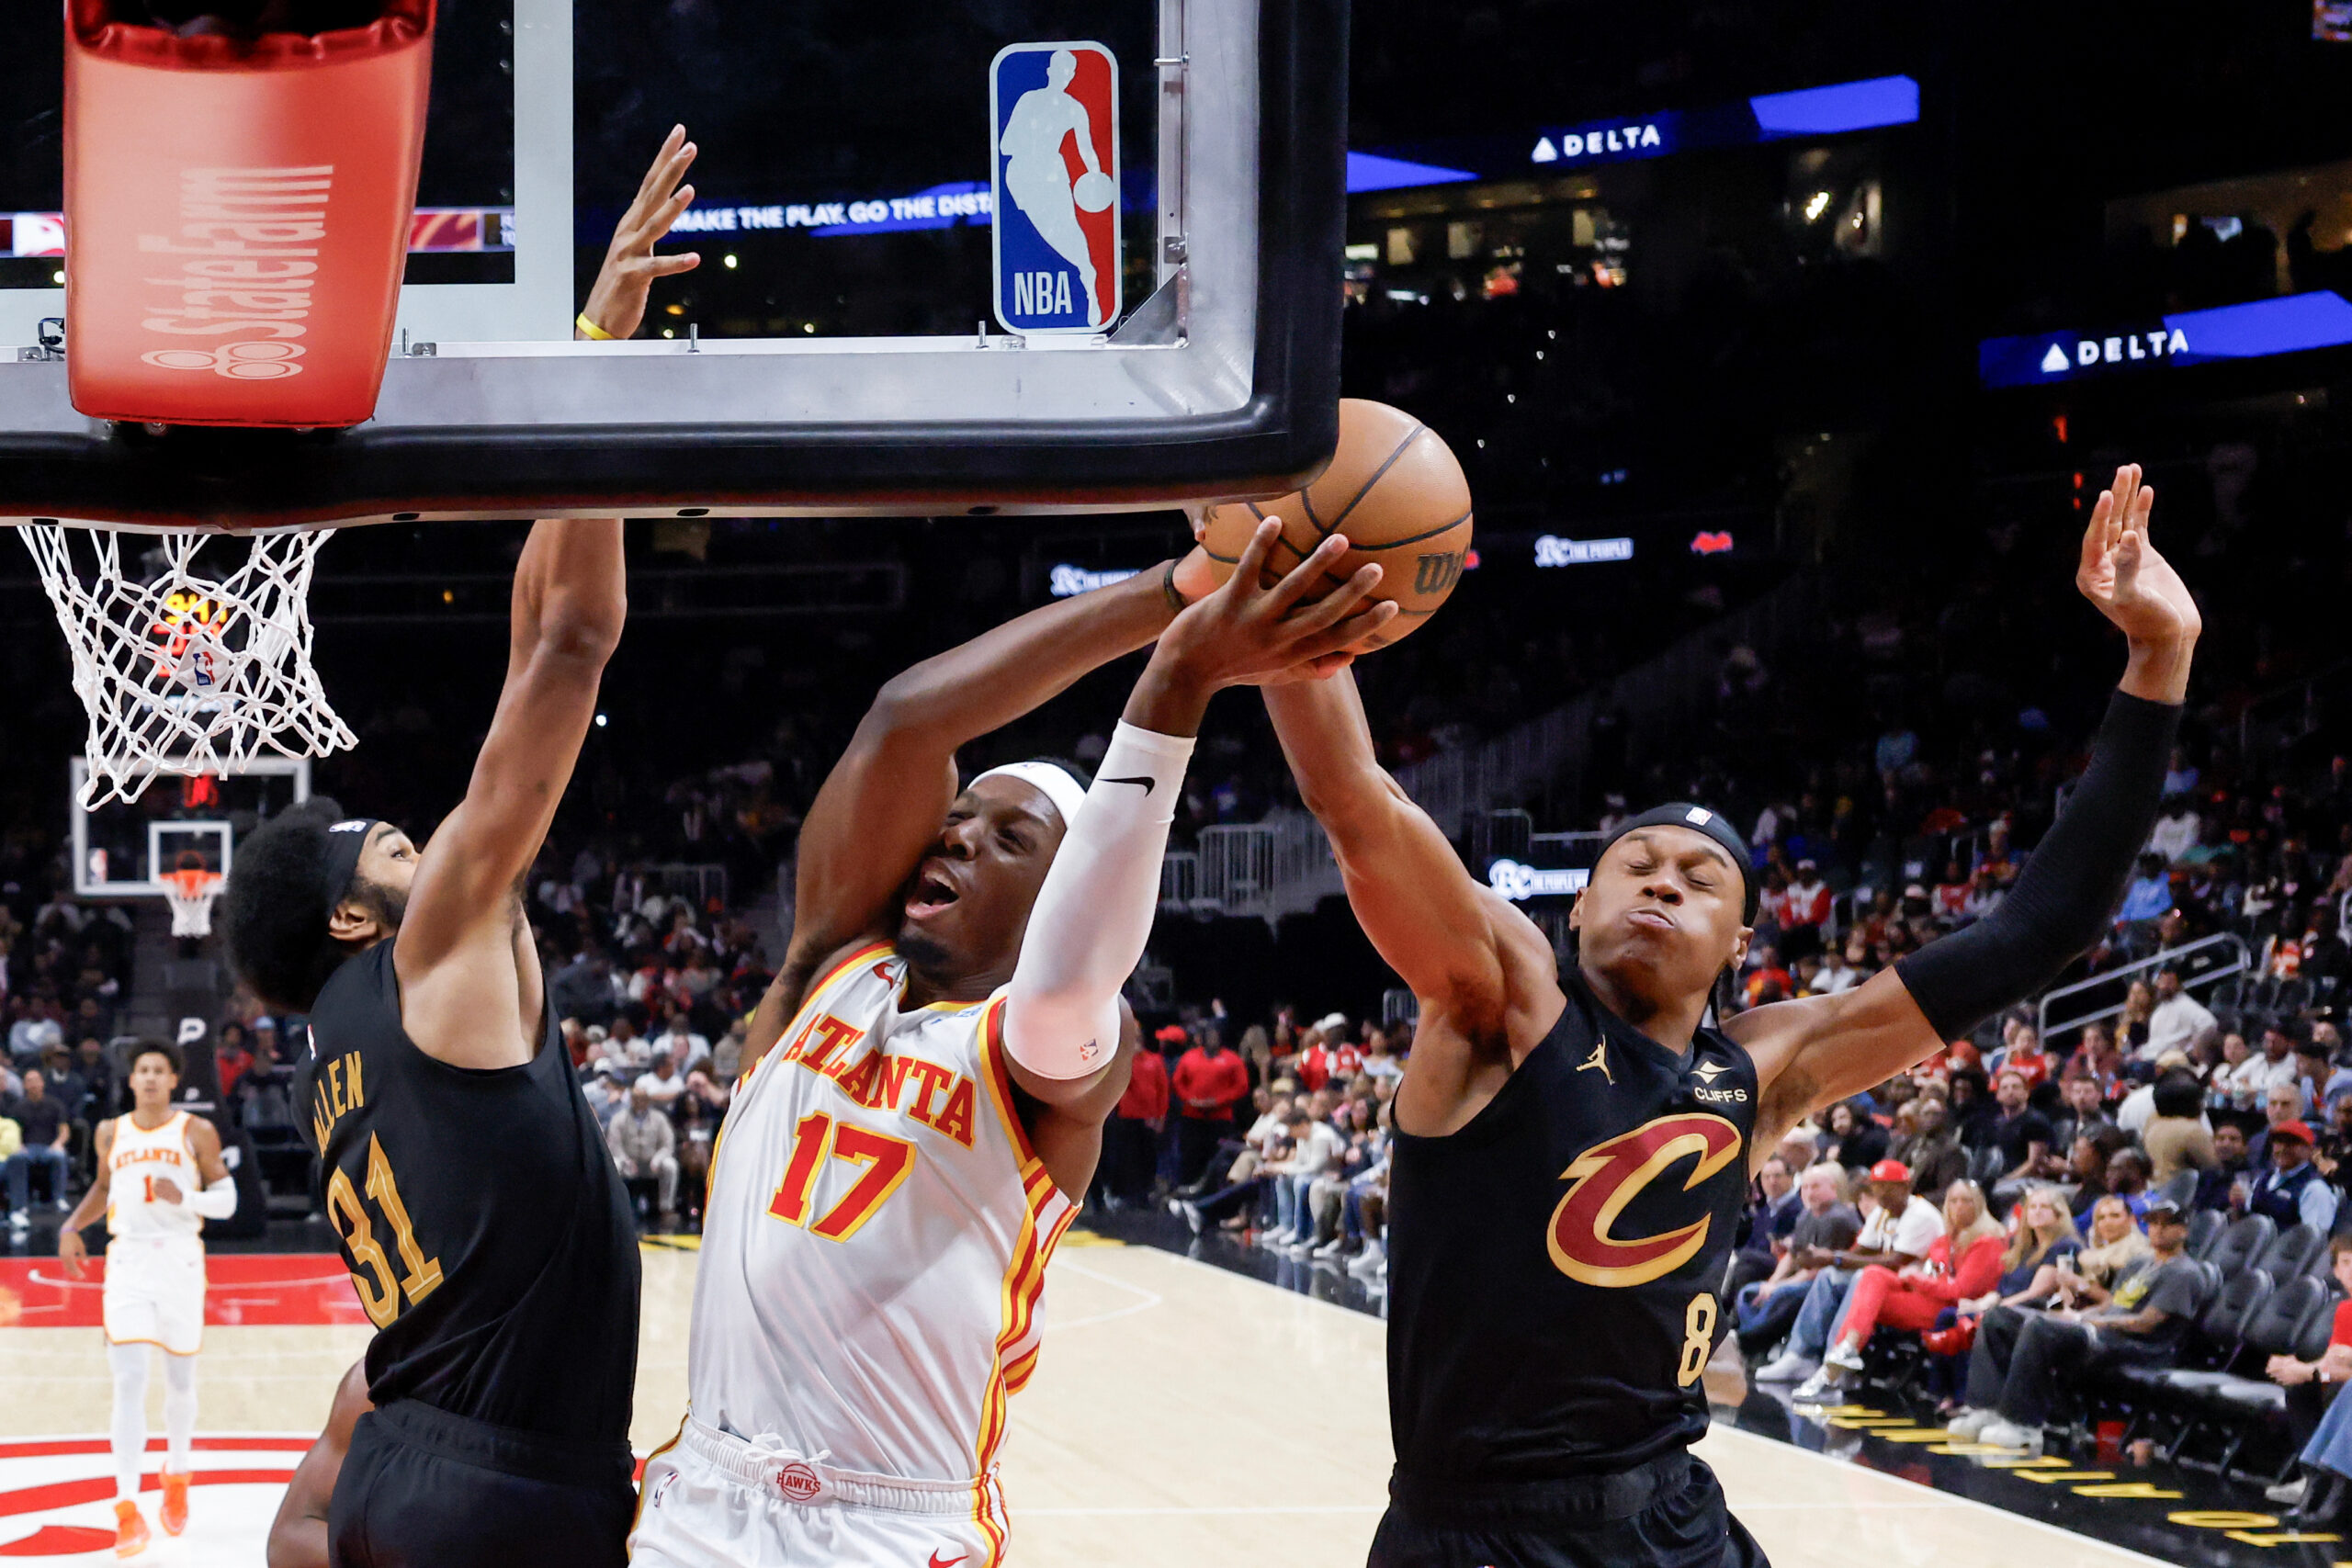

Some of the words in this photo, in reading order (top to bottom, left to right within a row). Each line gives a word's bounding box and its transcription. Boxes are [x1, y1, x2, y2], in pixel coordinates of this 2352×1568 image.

[1564, 124, 1660, 157] DELTA
[670, 208, 737, 231] MAKE
[738, 204, 785, 230] THE
[848, 199, 889, 224] GO
[889, 196, 937, 220] THE
[1013, 270, 1073, 316] NBA
[2077, 328, 2189, 366] DELTA
[781, 1012, 978, 1152] ATLANTA
[1694, 1087, 1747, 1102] CLIFFS
[313, 1050, 365, 1159] ALLEN
[115, 1146, 182, 1170] ATLANTA
[766, 1110, 917, 1244] 17
[143, 1174, 155, 1203] 1
[327, 1129, 445, 1330] 31
[1678, 1292, 1718, 1387] 8
[776, 1472, 820, 1493] HAWKS
